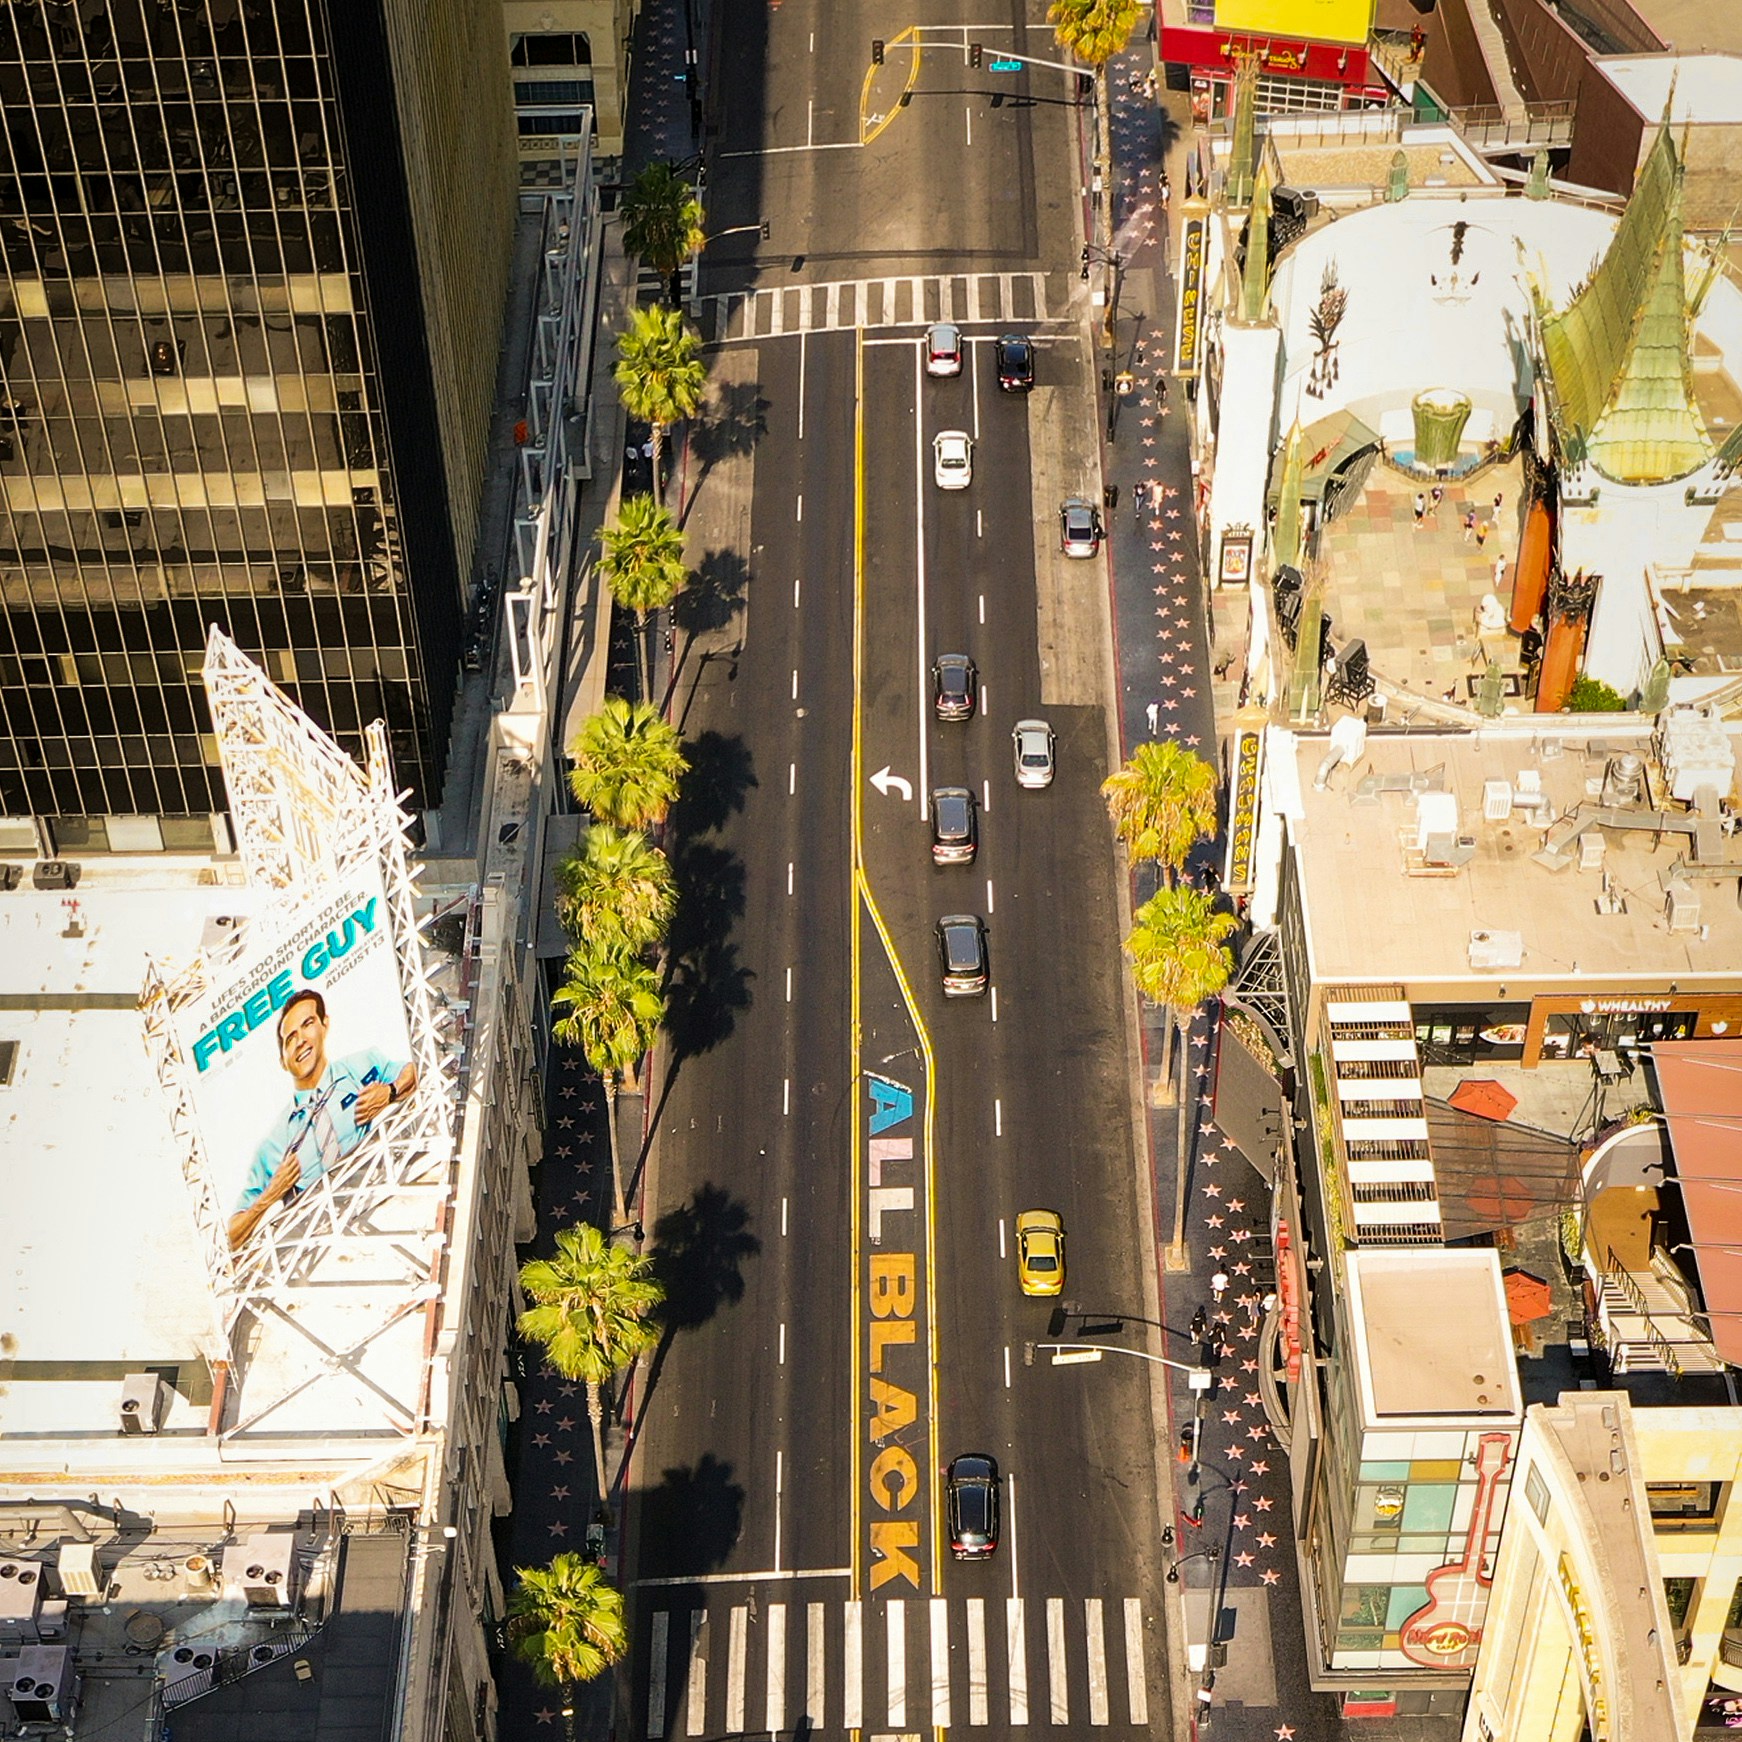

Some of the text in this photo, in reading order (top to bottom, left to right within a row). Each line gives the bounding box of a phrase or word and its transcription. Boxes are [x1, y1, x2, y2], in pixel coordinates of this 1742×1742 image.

[1181, 231, 1201, 361] CHINESE
[192, 896, 378, 1073] FREE GUY
[199, 890, 369, 1034] A BACKGROUND CHARACTER.
[211, 890, 353, 1010] LIFE'S TOO SHORT TO BE
[326, 935, 385, 990] AUGUST 13
[1597, 1000, 1671, 1012] WHEALTHY
[868, 1077, 915, 1241] ALL
[869, 1253, 920, 1592] BLACK
